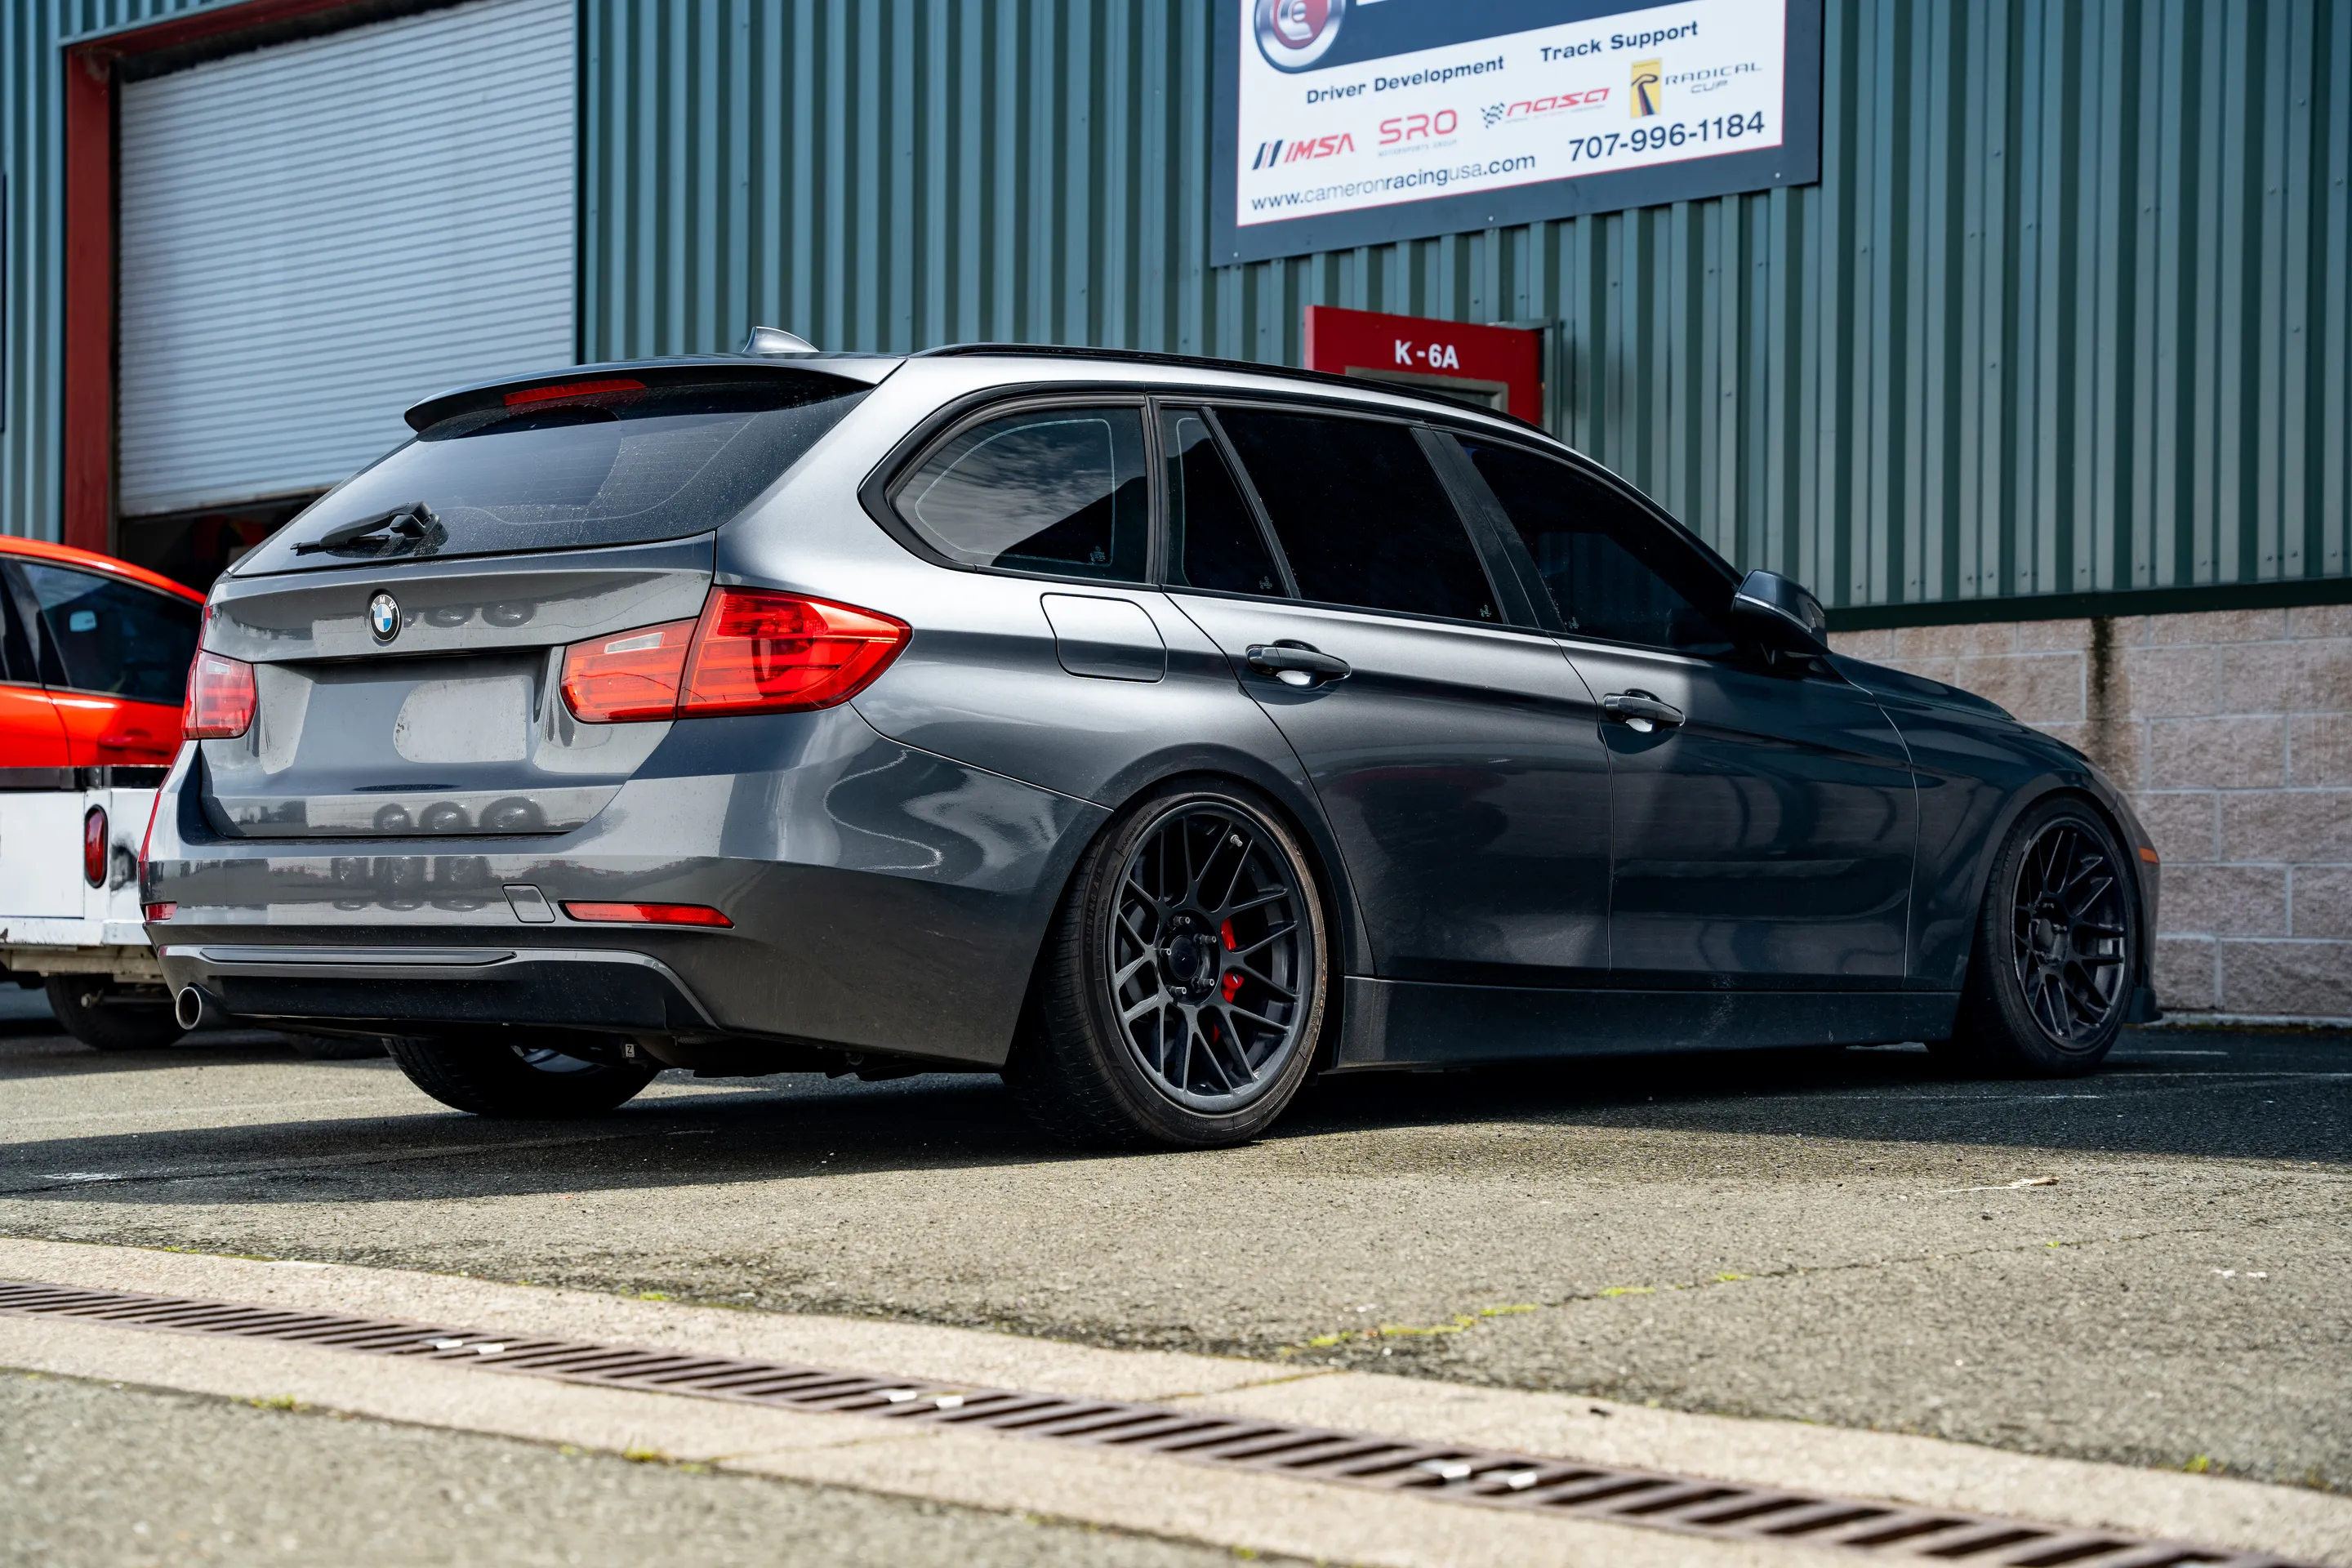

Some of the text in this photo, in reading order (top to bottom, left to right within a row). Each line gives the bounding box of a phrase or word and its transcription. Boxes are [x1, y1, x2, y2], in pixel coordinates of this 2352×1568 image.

[1540, 20, 1699, 62] Track Support
[1307, 56, 1504, 105] Driver Development
[1665, 61, 1763, 85] RADICAL
[1690, 79, 1728, 94] CUP
[1379, 109, 1457, 145] SRO
[1569, 110, 1766, 163] 707-996-1184
[1285, 133, 1355, 163] IMSA
[1251, 154, 1535, 211] www.cameronracingusa.com
[371, 595, 396, 612] BMW
[1085, 895, 1098, 951] TOURING
